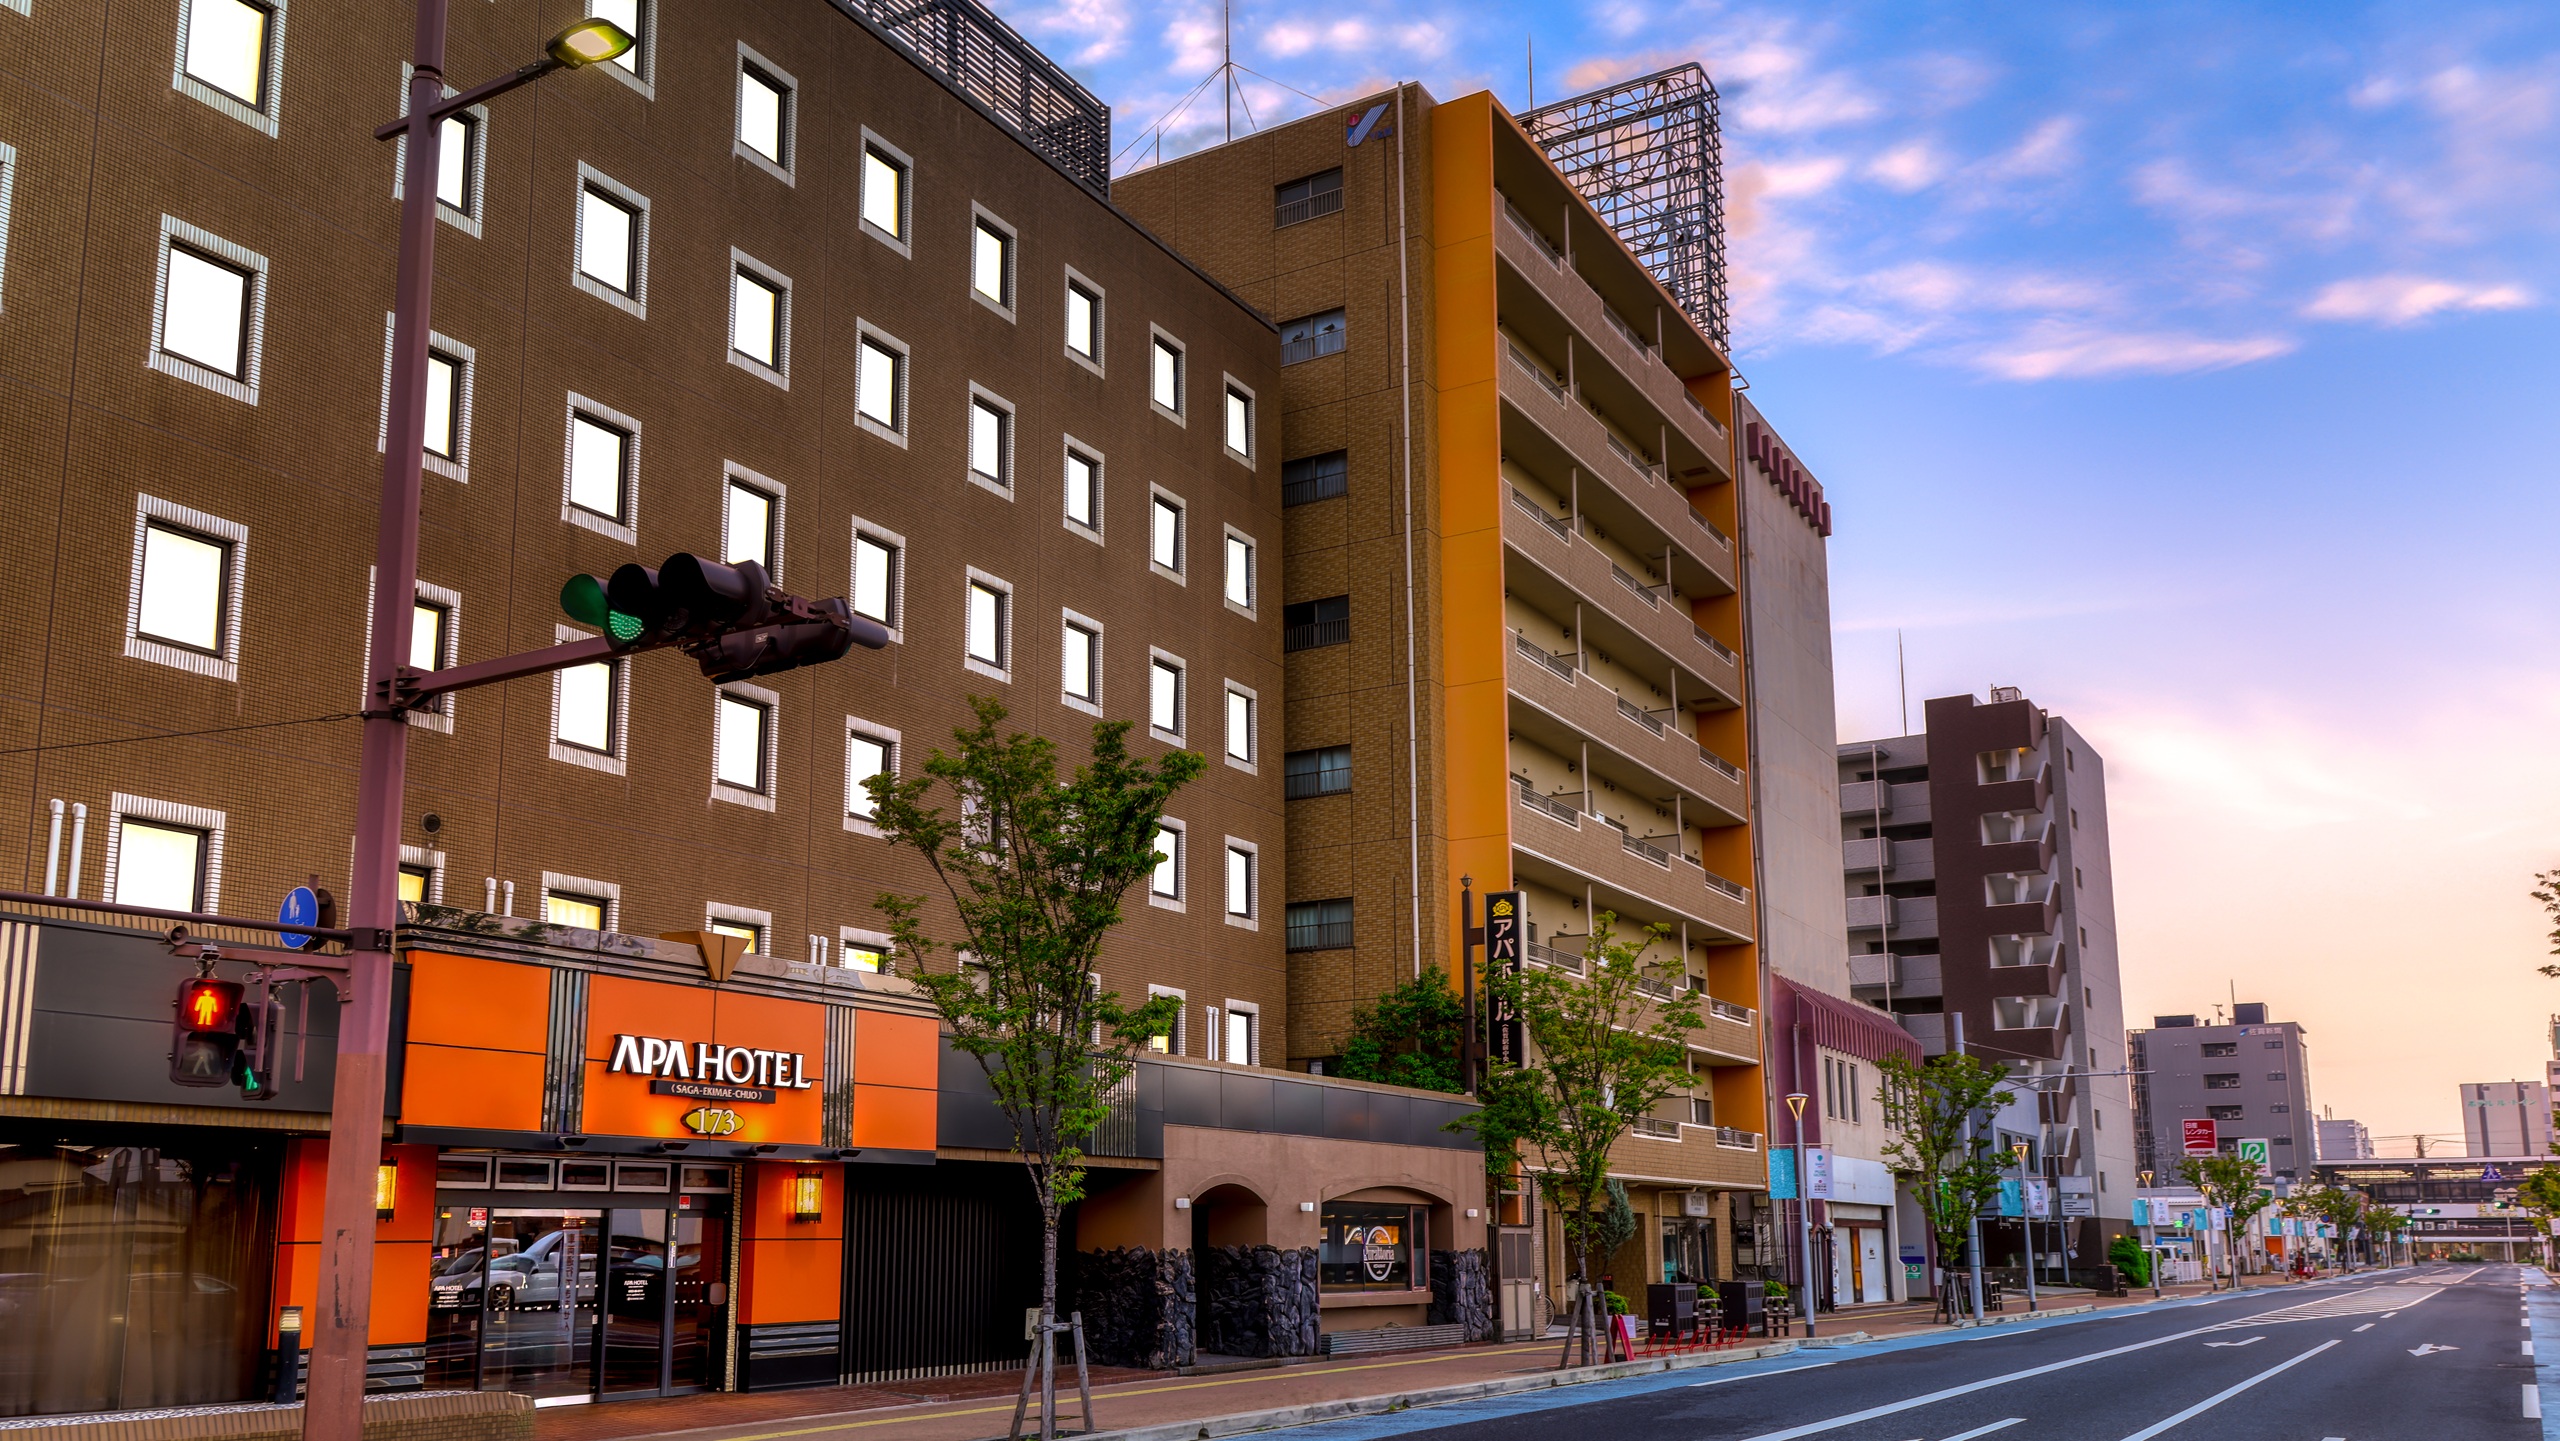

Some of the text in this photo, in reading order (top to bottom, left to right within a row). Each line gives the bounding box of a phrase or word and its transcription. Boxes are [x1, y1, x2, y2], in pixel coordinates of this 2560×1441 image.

[1493, 919, 1515, 1022] アパホル
[609, 1035, 812, 1089] APA HOTEL
[697, 1108, 736, 1135] 173
